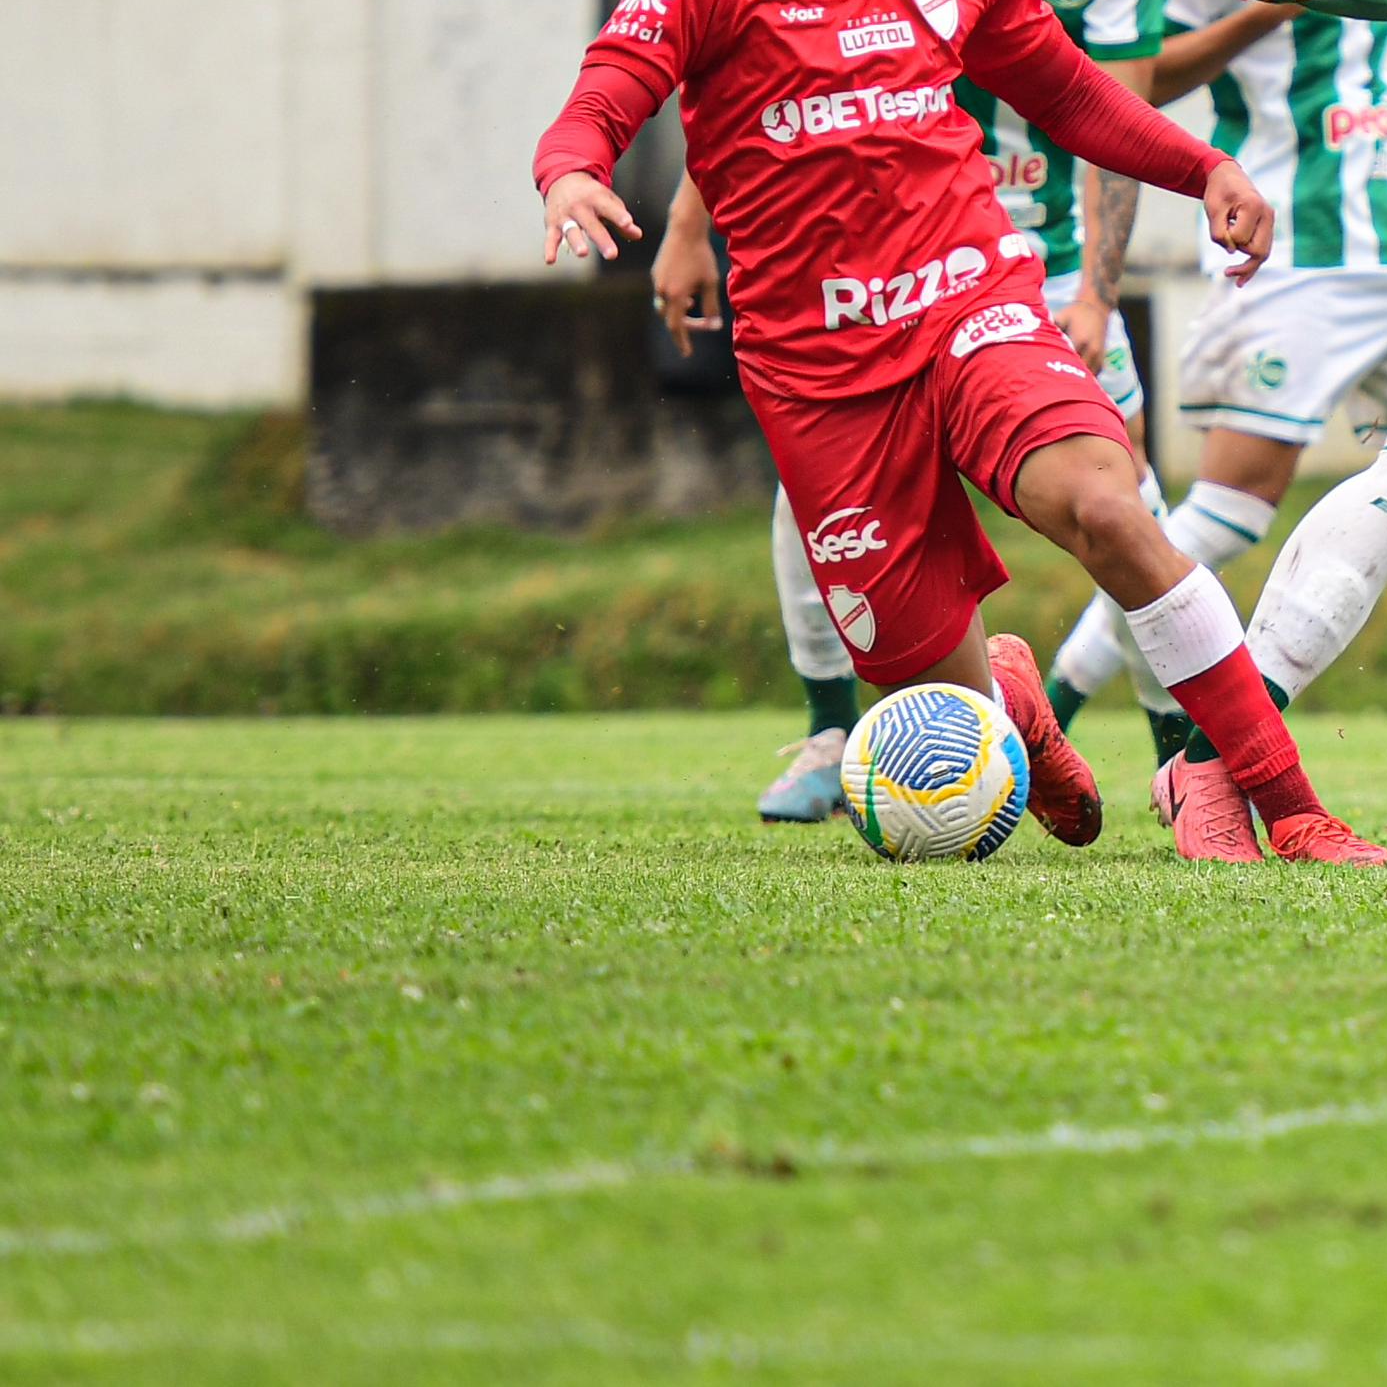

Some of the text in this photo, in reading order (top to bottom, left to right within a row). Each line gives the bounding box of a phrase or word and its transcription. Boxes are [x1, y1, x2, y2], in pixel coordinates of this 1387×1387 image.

[780, 6, 825, 23] VOLT
[847, 11, 899, 29] TINTAS
[842, 26, 911, 52] LUZTOL
[822, 246, 987, 331] Rizzo
[807, 519, 888, 564] sesc
